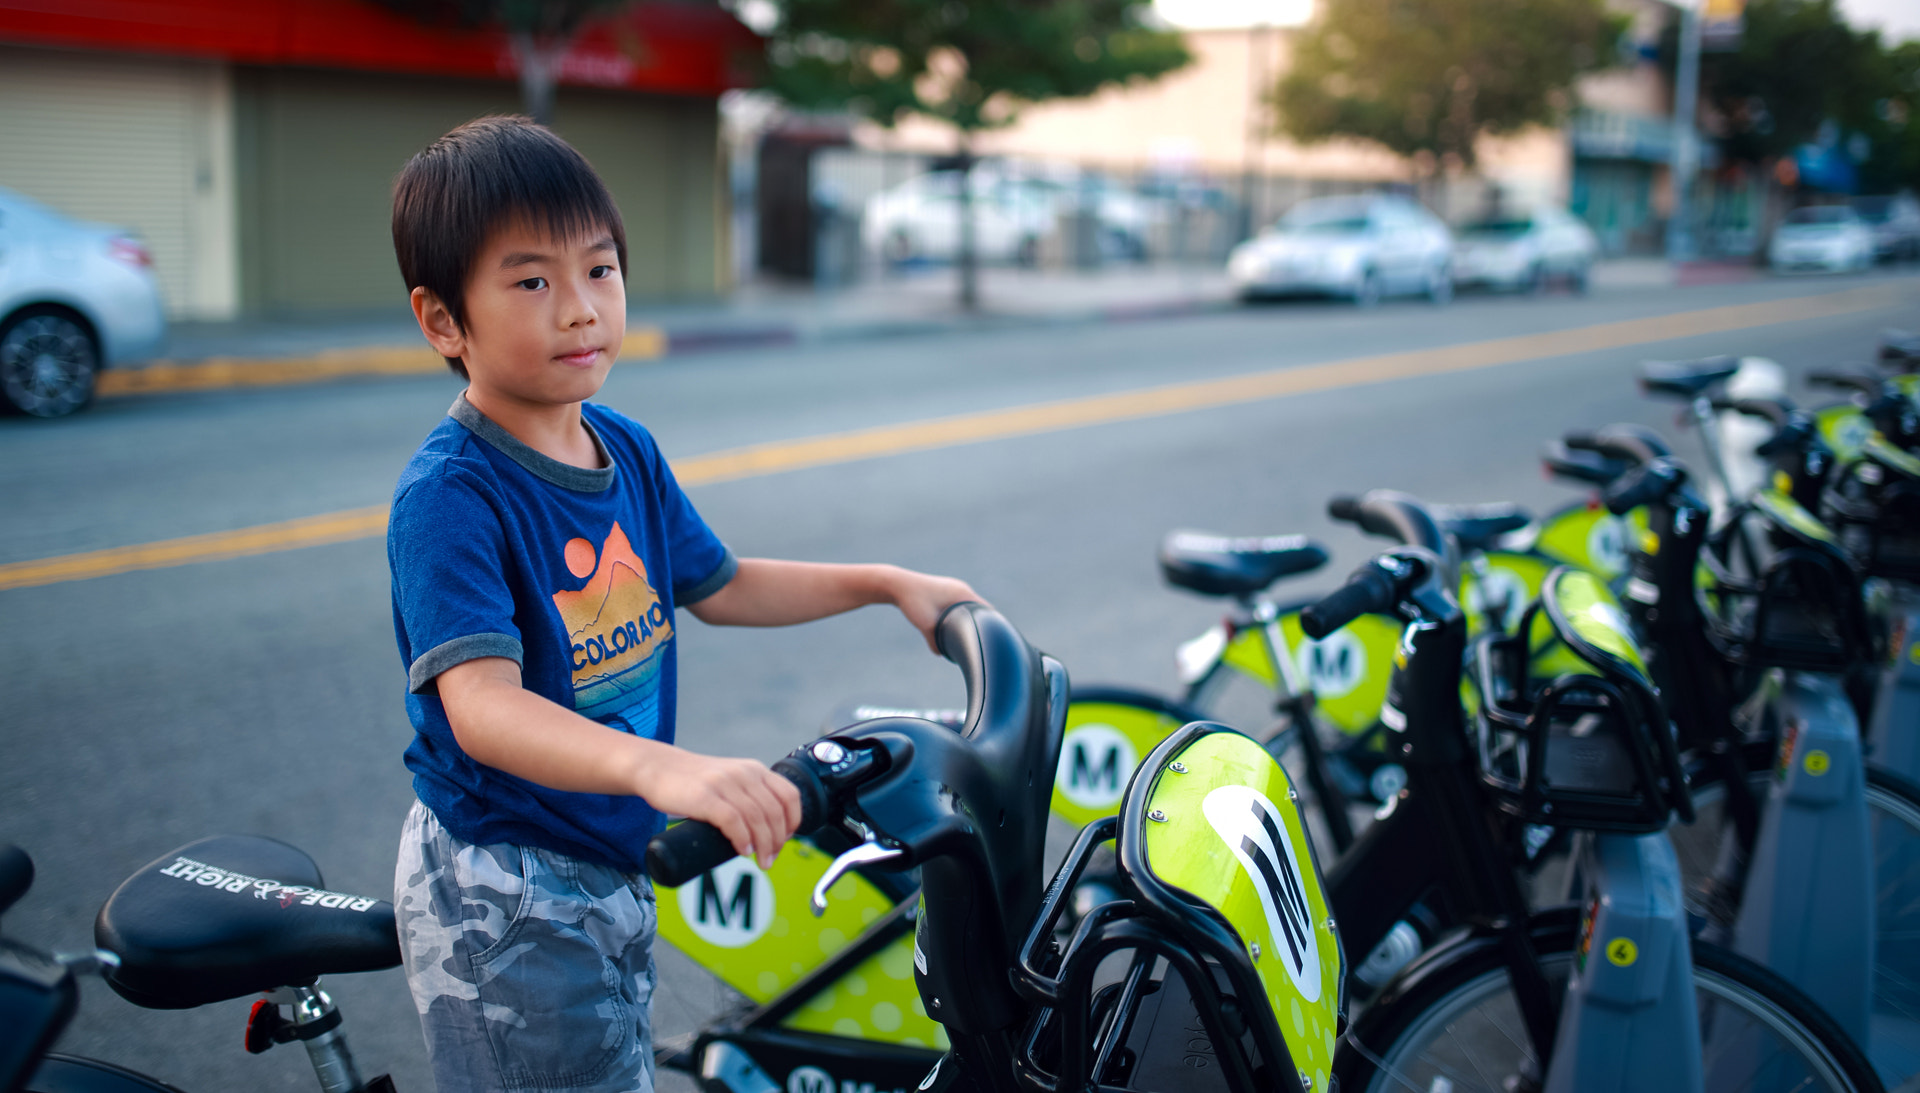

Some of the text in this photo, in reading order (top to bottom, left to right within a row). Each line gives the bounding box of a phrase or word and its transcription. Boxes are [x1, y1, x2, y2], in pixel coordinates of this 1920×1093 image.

[1071, 743, 1118, 790] M
[160, 861, 252, 894] RIGHT
[697, 870, 752, 931] M
[1240, 799, 1309, 978] M
[300, 892, 377, 912] RIDE
